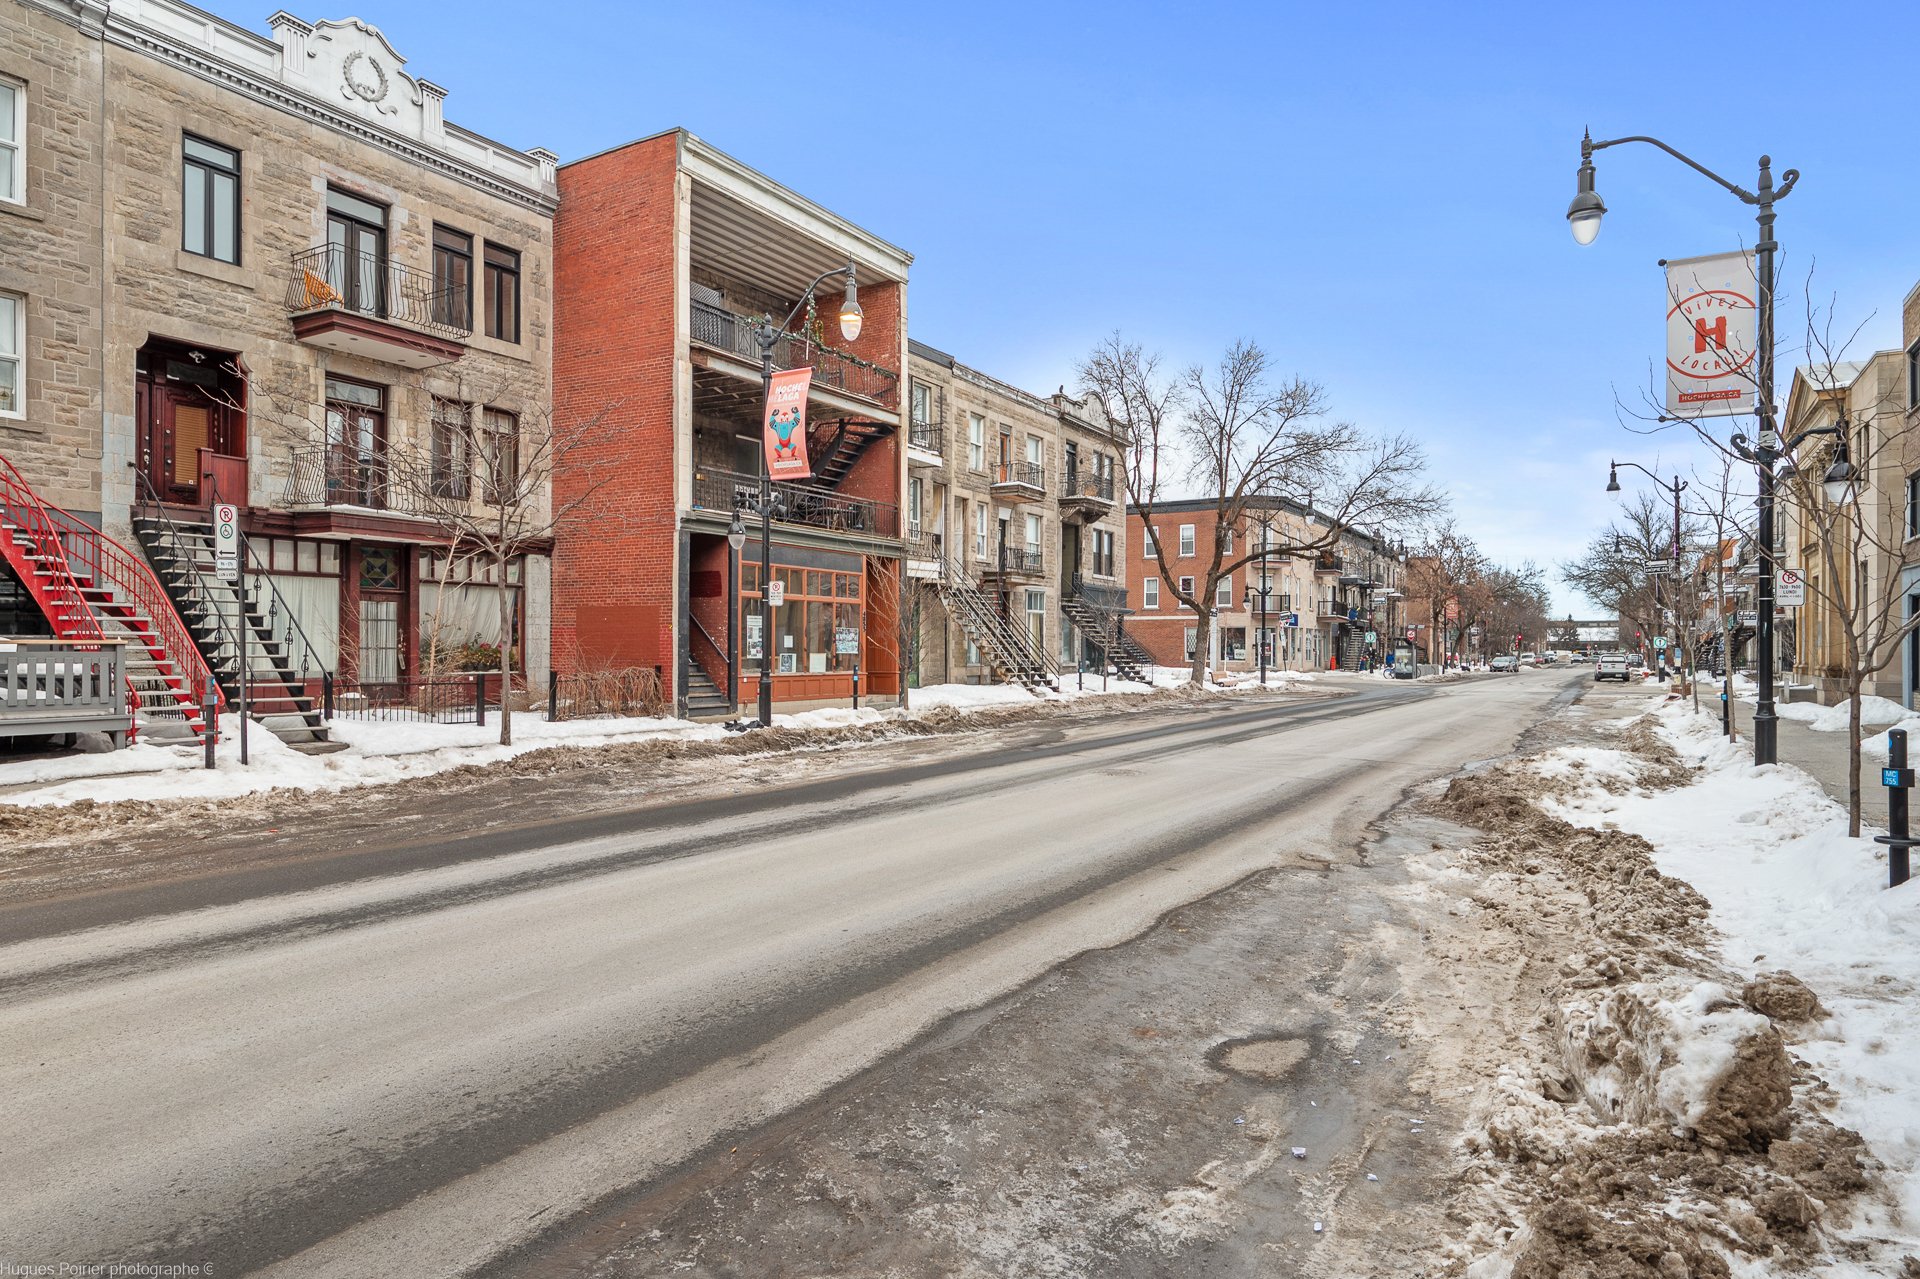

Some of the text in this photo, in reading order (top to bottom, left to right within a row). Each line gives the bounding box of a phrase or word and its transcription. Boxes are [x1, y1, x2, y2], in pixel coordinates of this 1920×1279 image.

[1695, 316, 1726, 354] H
[1681, 350, 1743, 371] LOCAL!
[1885, 770, 1897, 778] MC
[1885, 777, 1897, 785] 755
